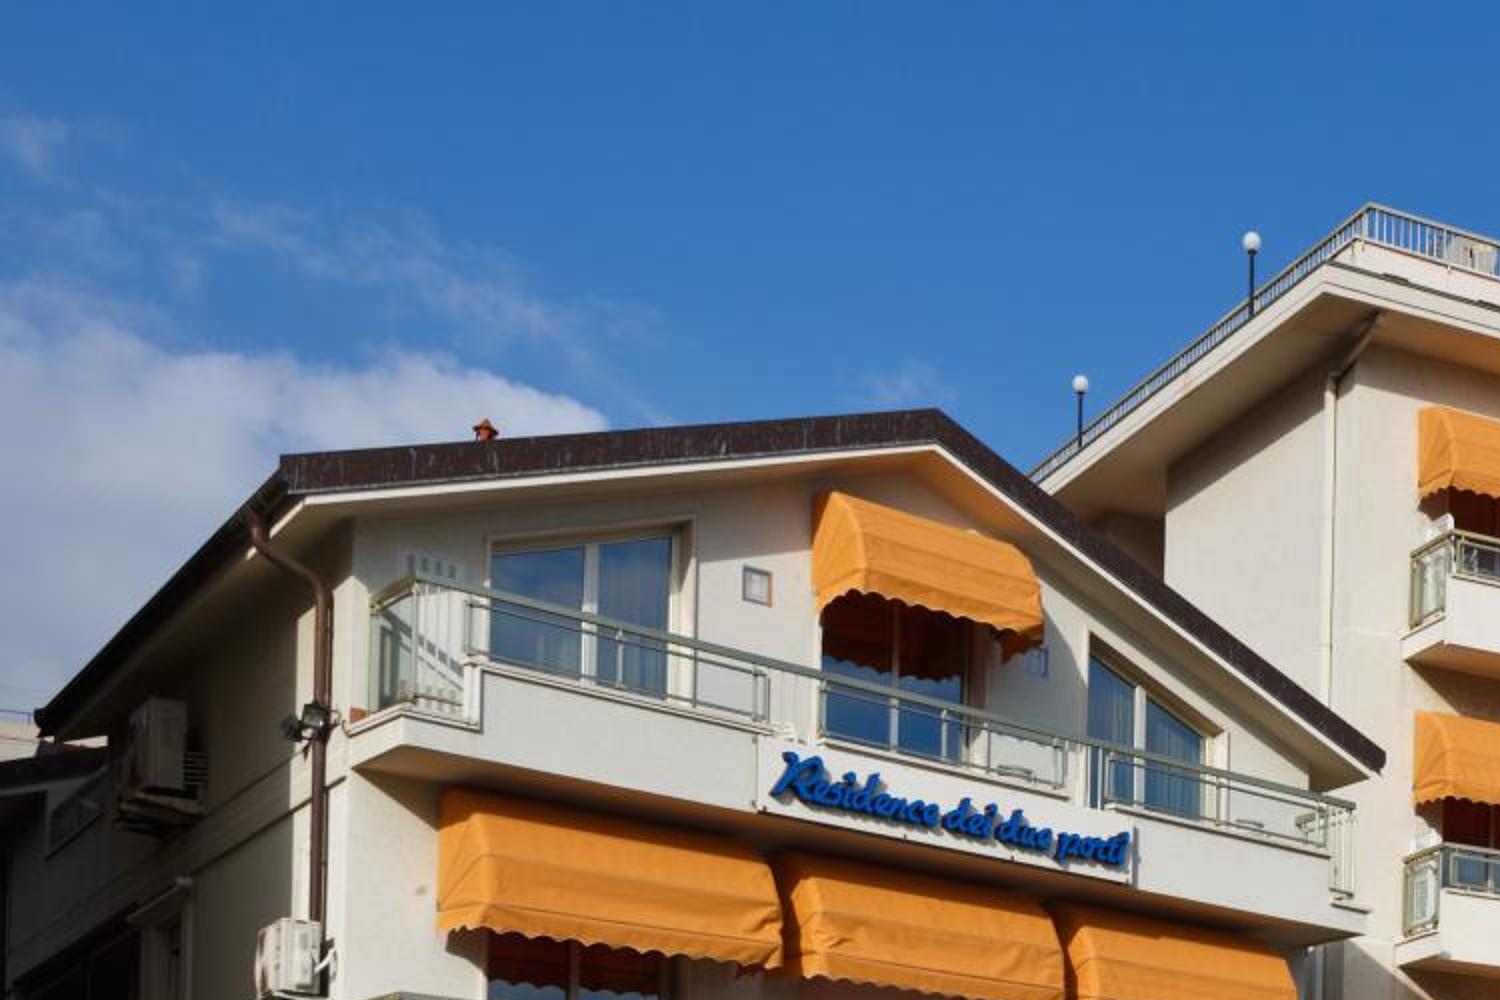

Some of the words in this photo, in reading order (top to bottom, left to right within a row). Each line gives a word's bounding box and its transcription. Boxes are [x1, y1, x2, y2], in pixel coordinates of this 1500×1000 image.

[771, 750, 940, 826] Residence
[943, 798, 998, 838] dei
[998, 809, 1052, 850] due
[1058, 830, 1131, 865] porti
